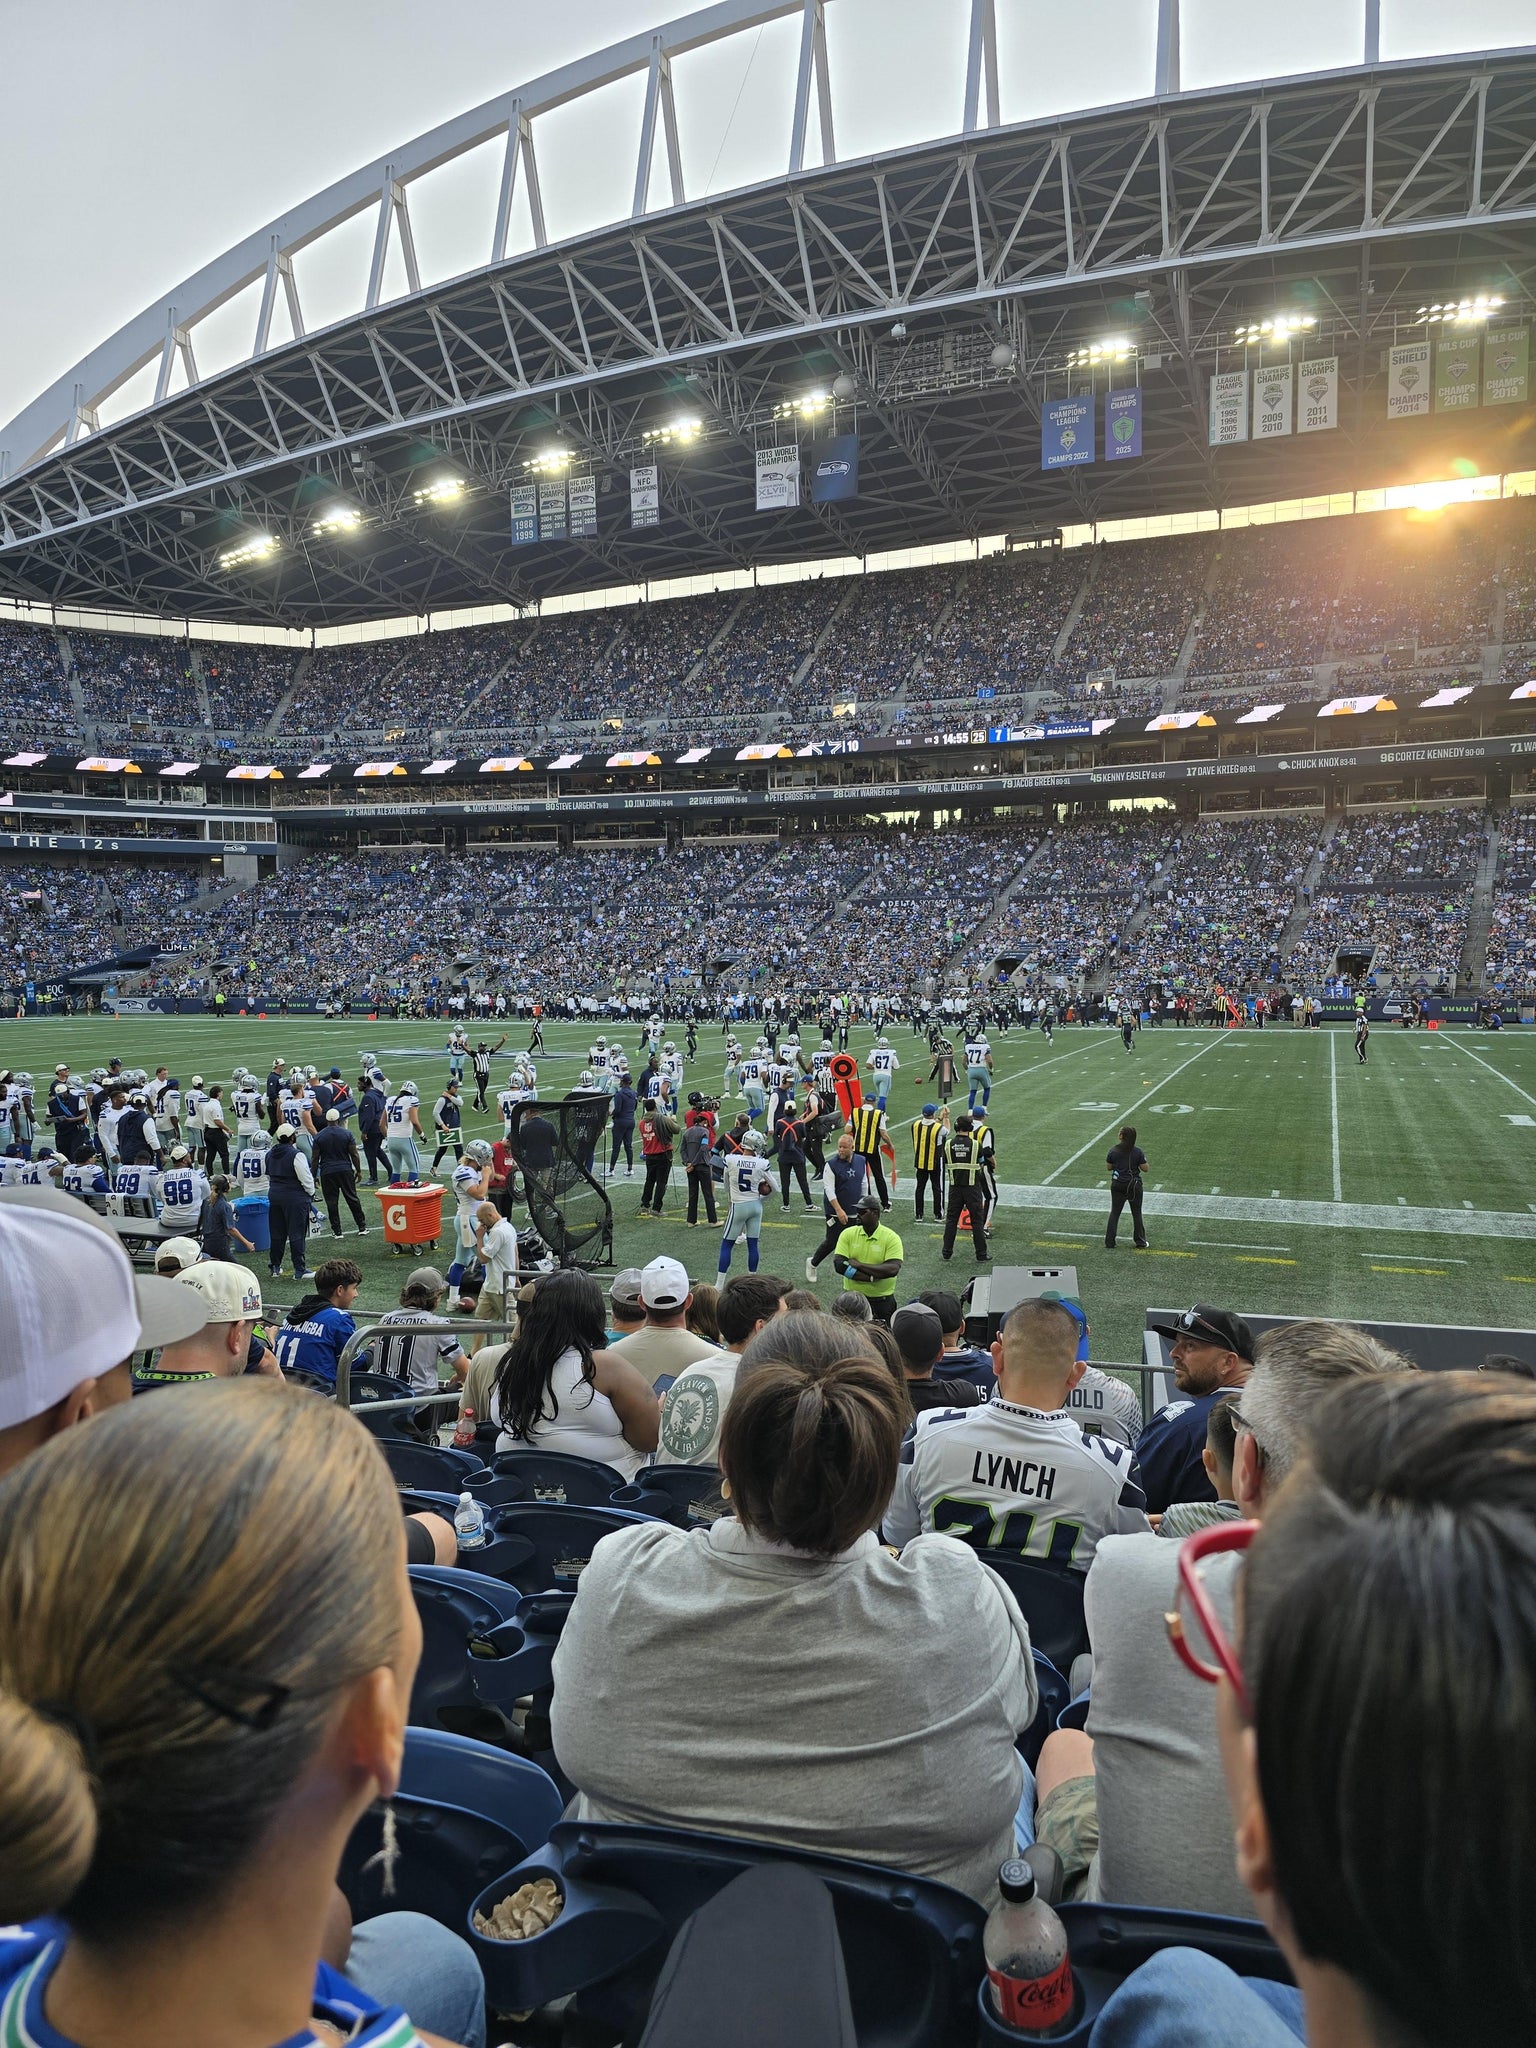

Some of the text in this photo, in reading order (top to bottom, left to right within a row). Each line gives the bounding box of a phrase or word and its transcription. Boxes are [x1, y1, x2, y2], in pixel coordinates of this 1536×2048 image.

[1487, 331, 1527, 344] MLS CUP
[1438, 338, 1478, 352] MLS CUP
[1392, 352, 1428, 366] SHIELD
[1302, 365, 1335, 377] CHAMPS
[1217, 375, 1241, 384] LEAGUE
[1257, 372, 1290, 384] CHAMPS
[1486, 376, 1525, 390] CHAMPS
[1216, 382, 1243, 391] CHAMPS
[1438, 384, 1476, 397] CHAMPS
[1492, 387, 1518, 399] 2019
[1110, 399, 1137, 410] CHAMPS
[1390, 392, 1428, 406] CHAMPS
[1444, 394, 1469, 406] 2016
[1050, 407, 1087, 420] CHAMPIONS
[1221, 409, 1237, 417] 1995
[1307, 406, 1327, 416] 2011
[1397, 404, 1420, 414] 2014
[1056, 416, 1080, 426] LEAGUE
[1221, 417, 1237, 425] 1996
[1262, 412, 1283, 423] 2009
[1307, 416, 1328, 426] 2014
[1220, 425, 1237, 433] 2005
[1262, 422, 1282, 433] 2010
[1220, 433, 1237, 441] 2007
[758, 446, 796, 459] 2013 WORLD
[1116, 446, 1131, 454] 2025
[758, 454, 797, 467] CHAMPIONS
[1048, 452, 1088, 464] CHAMPS 2022
[637, 477, 650, 486] NFC
[541, 489, 565, 499] CHAMPS
[570, 484, 594, 494] CHAMPS
[631, 484, 657, 494] CHAMPIONS
[758, 486, 787, 497] XLVIII
[512, 493, 535, 503] CHAMPS
[515, 520, 533, 530] 1988
[516, 530, 534, 540] 1999
[995, 727, 1090, 740] 7 SEAHAWKS
[847, 740, 859, 751] 10
[934, 736, 939, 744] 3
[943, 732, 969, 744] 14:55
[973, 732, 984, 742] 25
[1510, 743, 1523, 752] 71
[1380, 753, 1394, 762] 96
[1395, 750, 1425, 761] CORTEZ
[1427, 748, 1465, 759] KENNEDY
[1292, 759, 1317, 769] CHUCK
[1318, 758, 1339, 767] KNOX
[1186, 768, 1197, 776] 17
[1198, 766, 1216, 775] DAVE
[1216, 765, 1239, 774] KRIEG
[1090, 774, 1102, 783] 45
[1103, 773, 1125, 782] KENNY
[1126, 771, 1150, 780] EASLEY
[928, 784, 942, 793] PAUL
[951, 783, 969, 791] ALLEN
[1002, 780, 1013, 788] 79
[1013, 778, 1033, 788] JACOB
[1034, 778, 1055, 786] GREEN
[770, 793, 784, 801] PETE
[833, 790, 843, 798] 28
[860, 788, 885, 797] WARNER
[556, 802, 572, 810] STEVE
[573, 801, 597, 810] LARGENT
[717, 796, 735, 804] BROWN
[377, 807, 410, 815] ALEXANDER
[473, 804, 487, 812] MIKE
[10, 836, 119, 850] THE 12s
[1330, 989, 1343, 998] 12
[594, 1056, 606, 1066] 96
[875, 1056, 889, 1069] 67
[969, 1050, 981, 1064] 77
[745, 1065, 758, 1079] 79
[235, 1102, 248, 1118] 17
[243, 1158, 262, 1179] 59
[737, 1160, 756, 1169] ANGER
[164, 1171, 192, 1181] BULLARD
[738, 1169, 752, 1192] 5
[164, 1179, 193, 1206] 98
[387, 1204, 407, 1231] G
[276, 1335, 301, 1367] 11
[676, 1380, 709, 1393] SEAVIEW
[665, 1394, 675, 1412] THE
[703, 1395, 713, 1431] SANDS
[664, 1424, 700, 1453] MALIBU
[972, 1450, 1056, 1500] LYNCH
